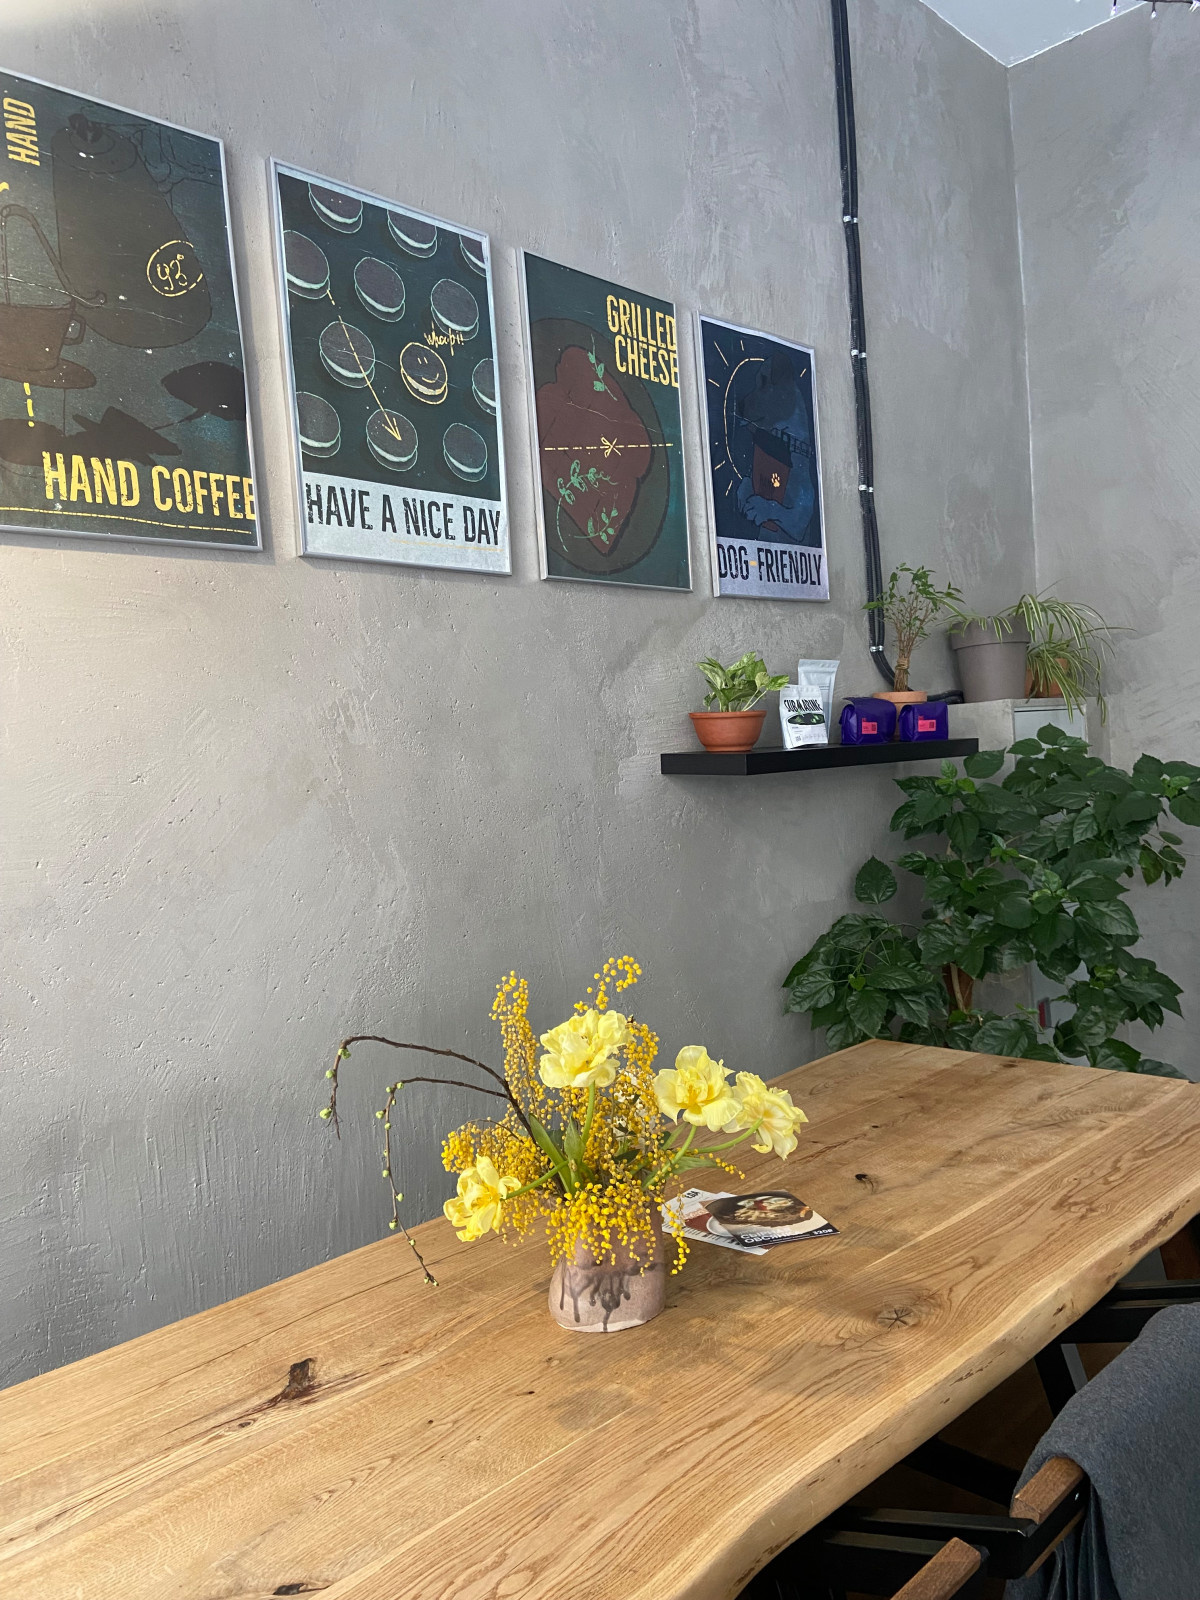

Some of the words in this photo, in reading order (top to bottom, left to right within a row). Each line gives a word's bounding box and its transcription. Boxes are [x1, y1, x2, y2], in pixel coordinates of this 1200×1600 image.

[3, 97, 41, 166] HAND
[606, 294, 677, 351] GRILLED
[614, 334, 679, 388] CHEESE
[42, 451, 141, 507] HAND
[152, 465, 257, 520] COFFEE
[306, 482, 374, 530] HAVE
[381, 494, 398, 534] A
[402, 497, 456, 541] NICE
[462, 505, 501, 546] DAY
